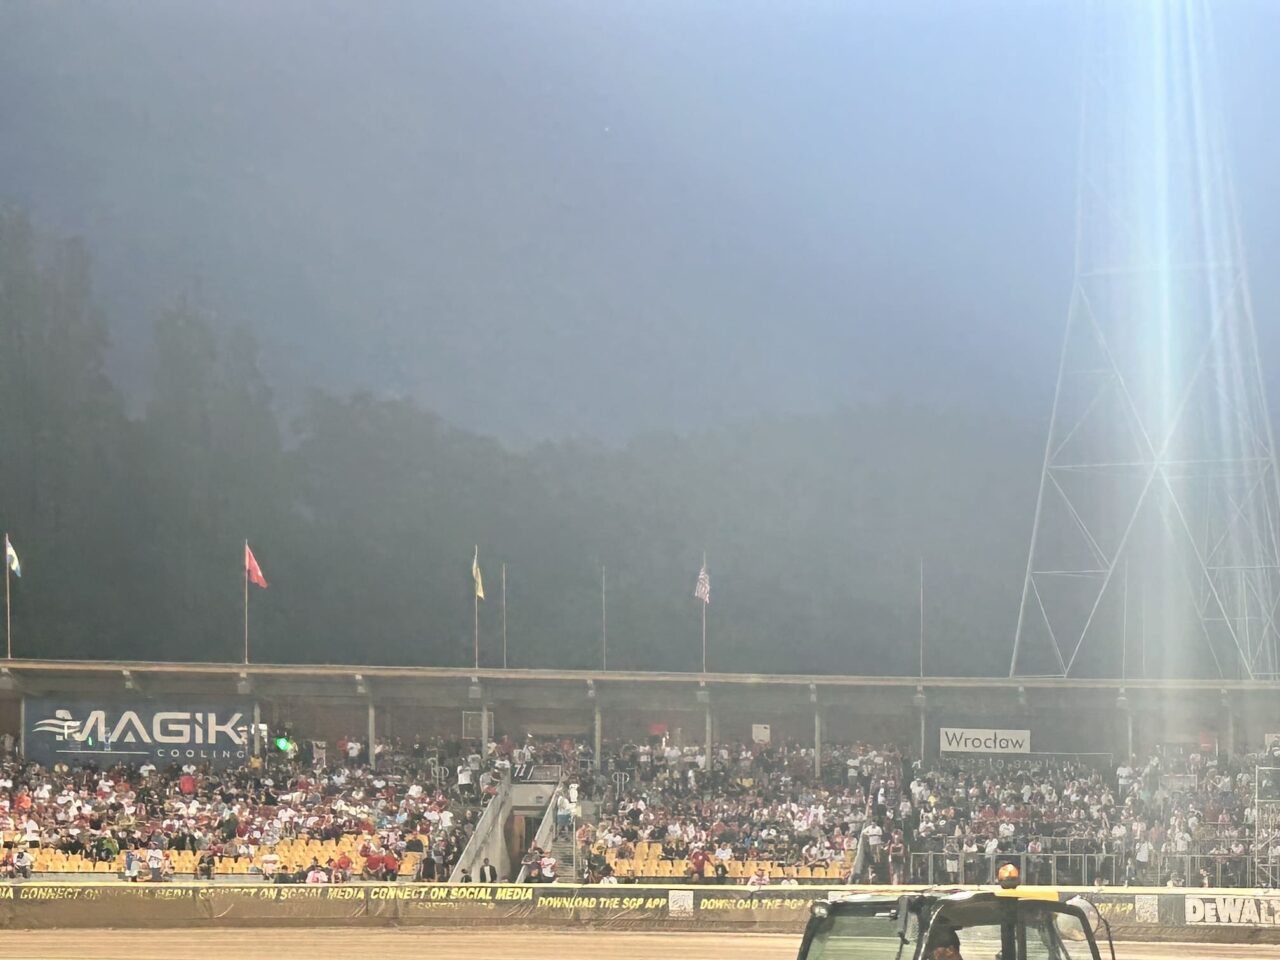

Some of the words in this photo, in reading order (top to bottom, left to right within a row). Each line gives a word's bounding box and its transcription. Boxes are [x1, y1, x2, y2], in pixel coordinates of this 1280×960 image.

[55, 709, 244, 745] MAGIK
[944, 731, 1025, 749] Wrocław
[157, 749, 245, 759] COOLING
[20, 888, 82, 899] CONNECT
[259, 888, 277, 899] ON
[327, 888, 365, 899] MEDIA
[370, 887, 428, 900] CONNECT
[430, 887, 447, 900] ON
[450, 887, 493, 900] SOCIAL
[495, 887, 533, 900] MEDIA
[537, 896, 597, 909] DOWNLOAD
[599, 897, 621, 909] THE
[622, 898, 644, 909] SGP
[645, 898, 667, 909] APP
